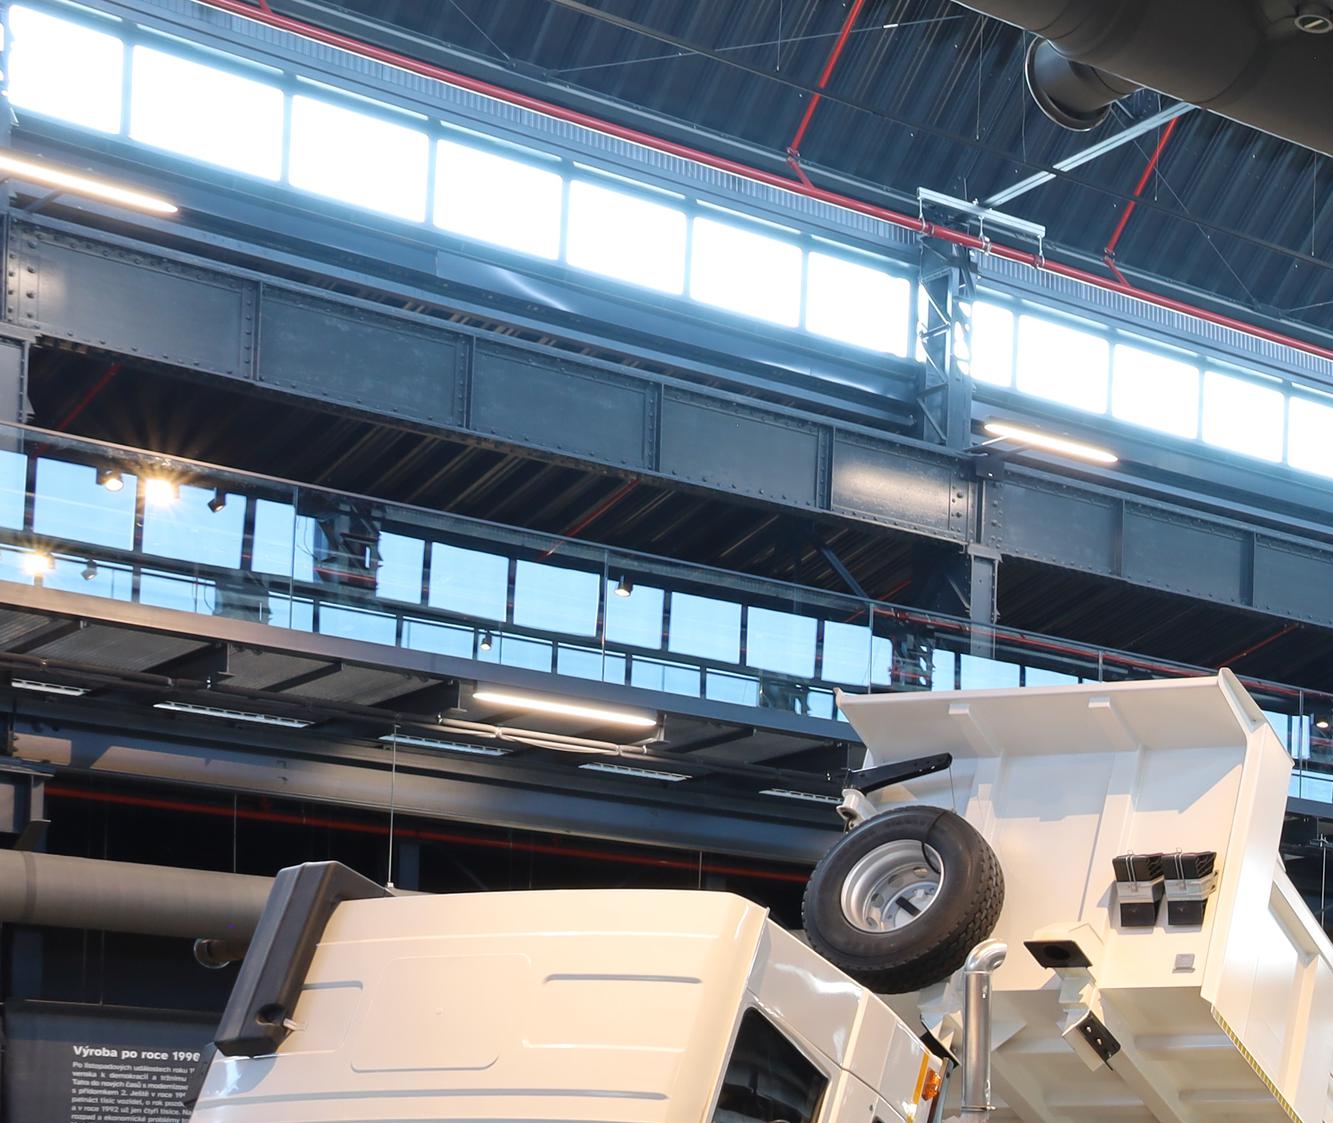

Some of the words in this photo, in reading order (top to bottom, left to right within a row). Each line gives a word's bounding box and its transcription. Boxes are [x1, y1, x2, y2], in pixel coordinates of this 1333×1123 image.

[73, 1045, 118, 1058] Výroba
[121, 1049, 138, 1059] po
[141, 1051, 169, 1060] roce
